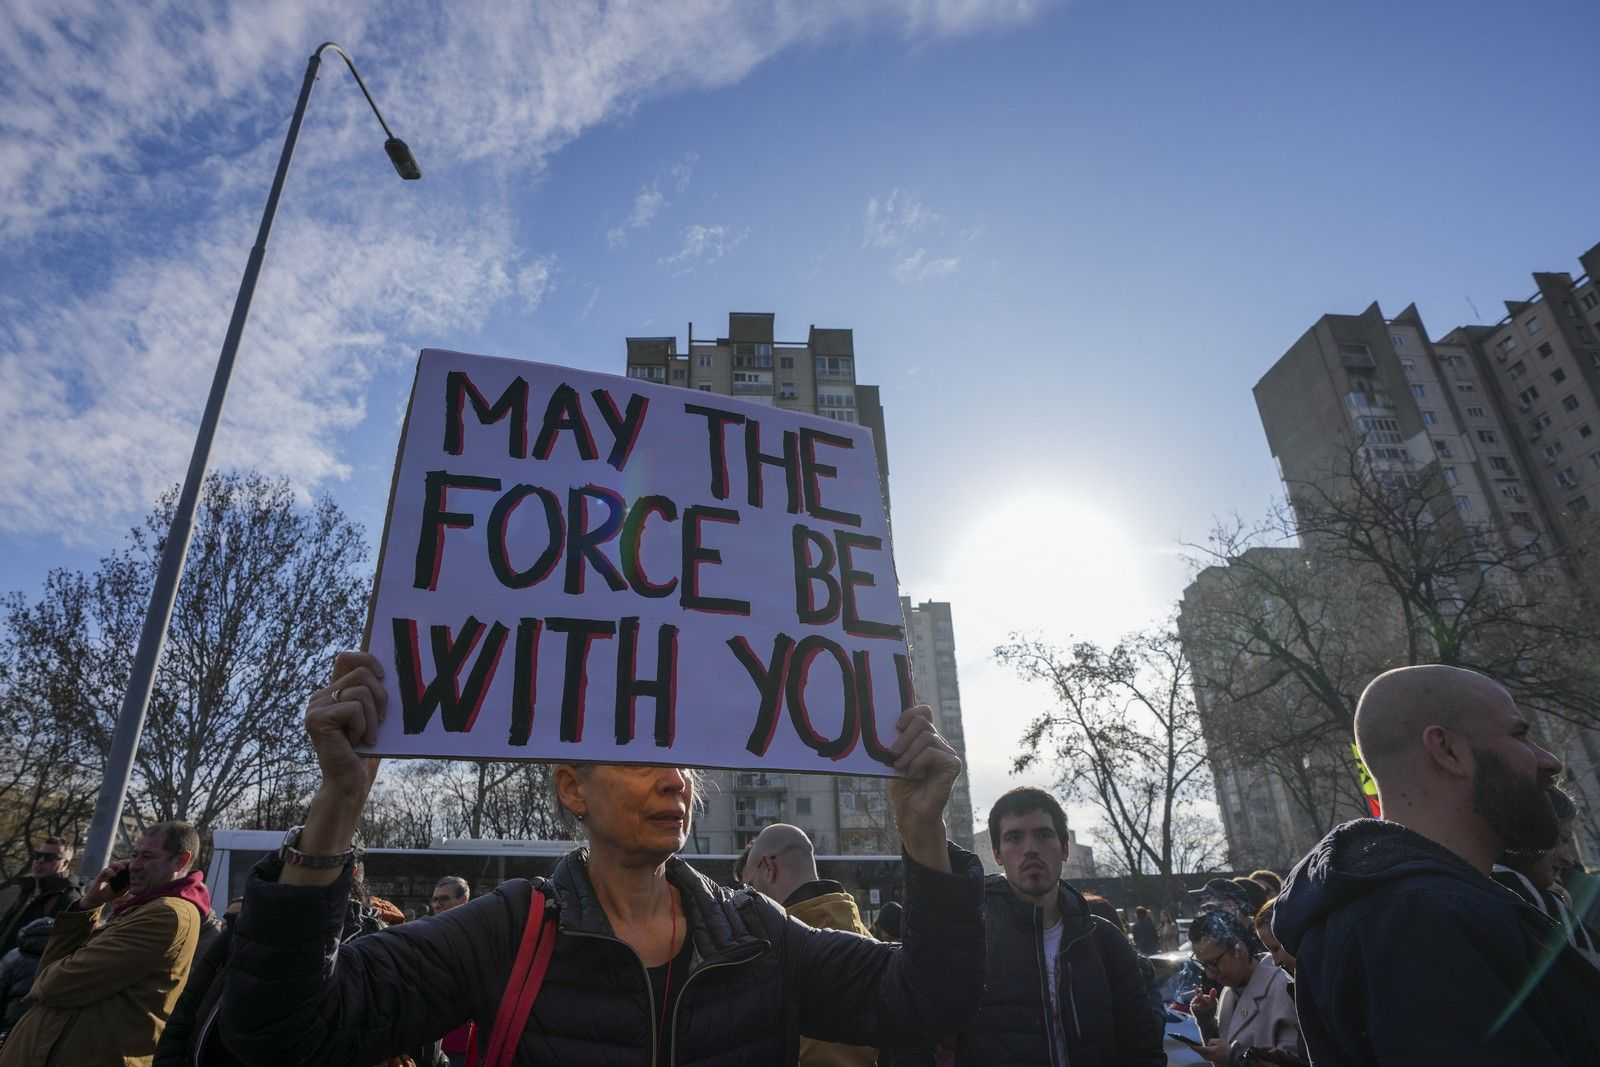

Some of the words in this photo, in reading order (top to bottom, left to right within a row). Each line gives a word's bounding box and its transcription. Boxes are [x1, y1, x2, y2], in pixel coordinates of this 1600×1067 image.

[443, 371, 649, 471] MAY
[685, 403, 861, 526] THE
[413, 470, 750, 616] FORCE
[793, 524, 903, 639] BE
[392, 616, 679, 747] WITH
[726, 633, 914, 767] YOU
